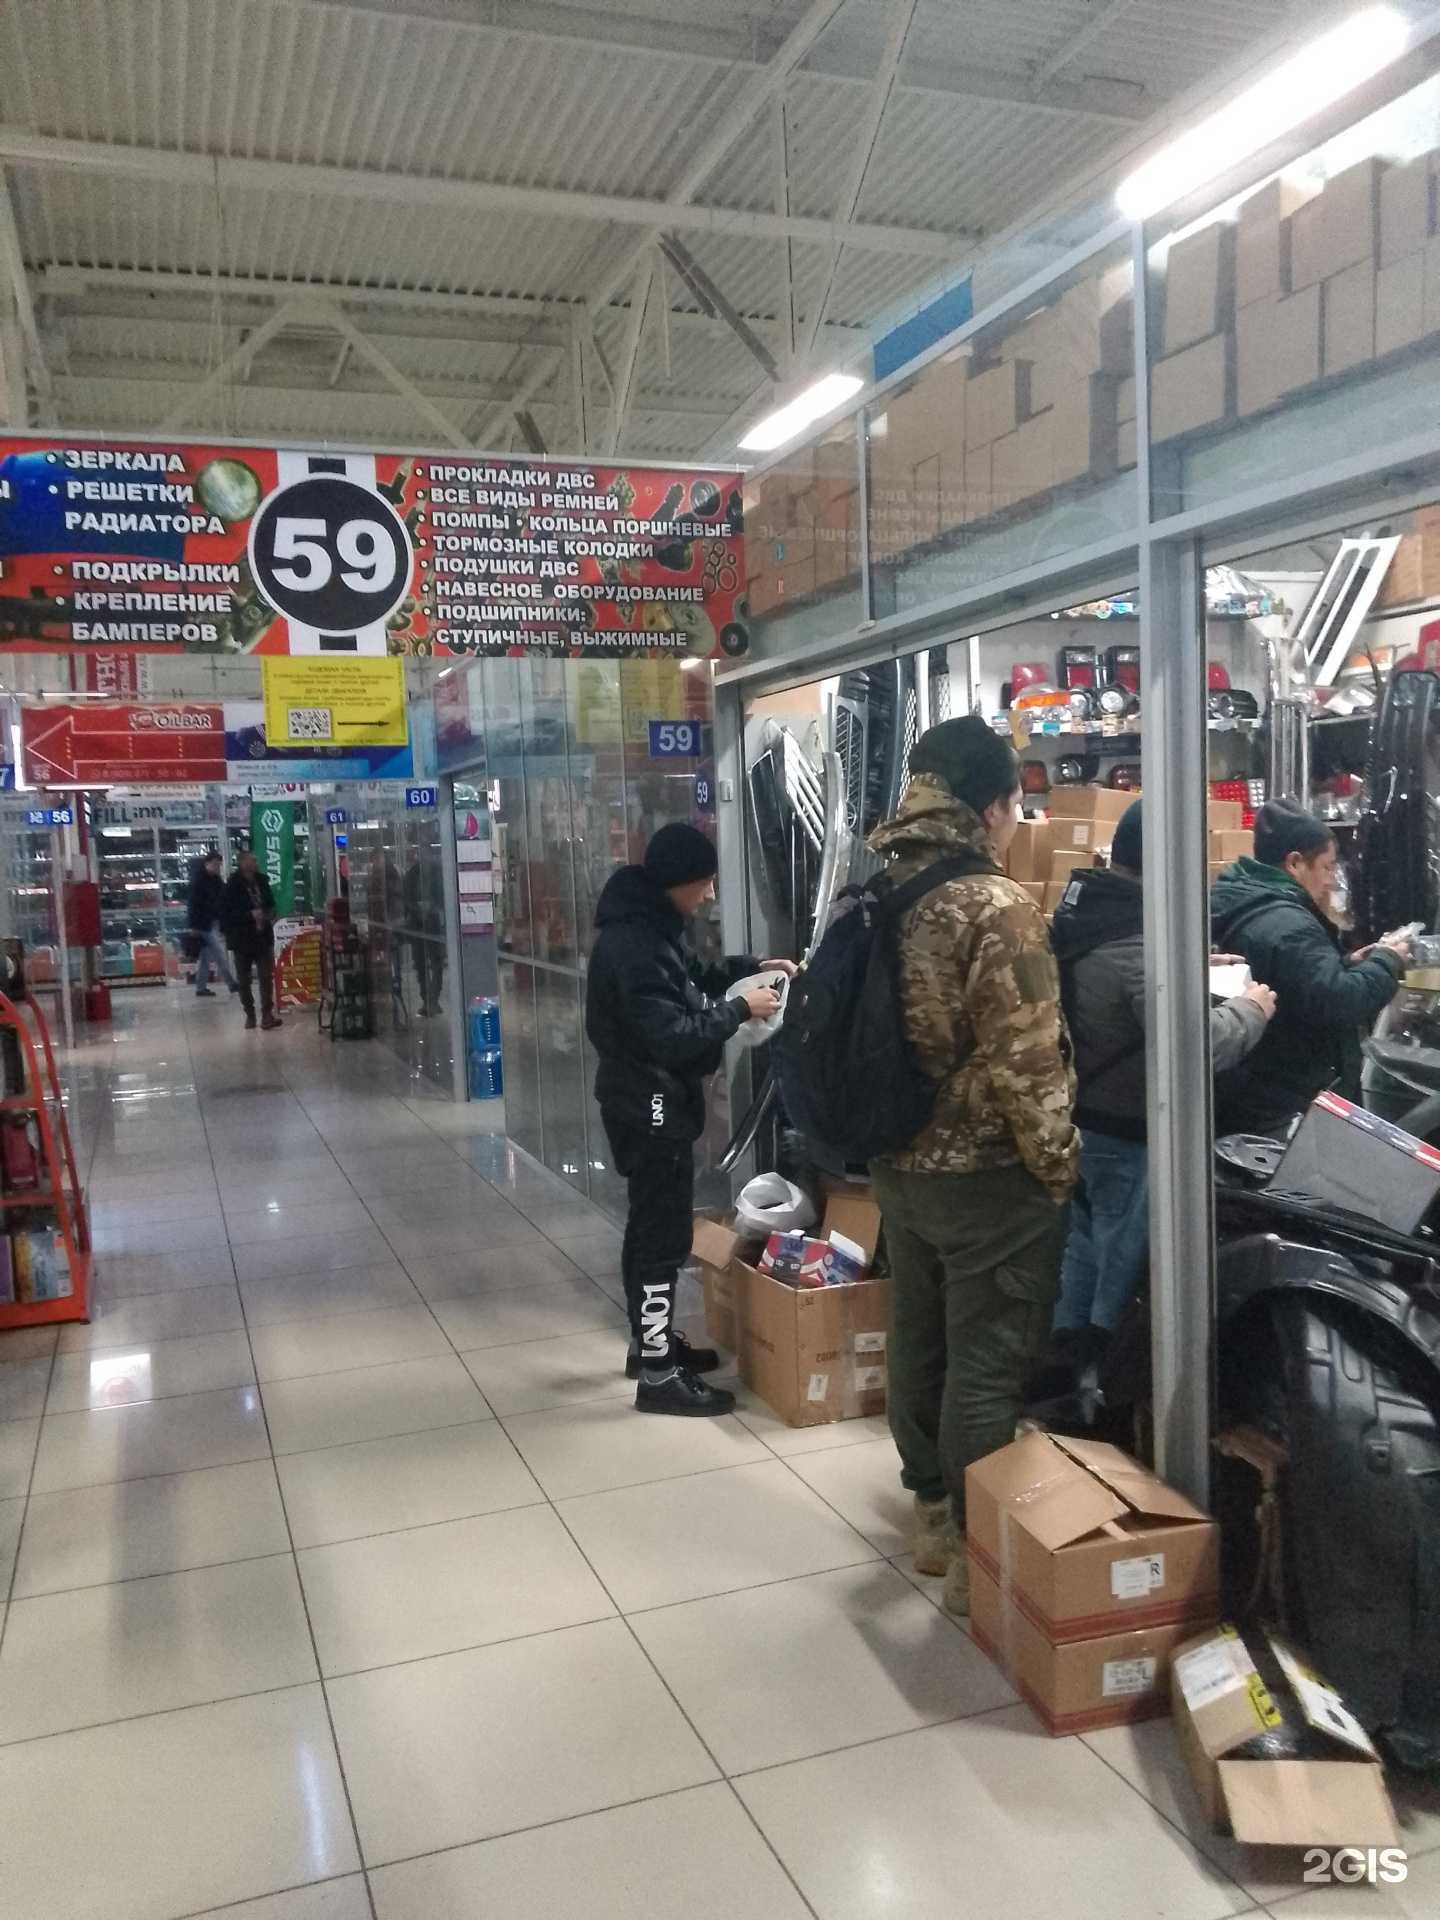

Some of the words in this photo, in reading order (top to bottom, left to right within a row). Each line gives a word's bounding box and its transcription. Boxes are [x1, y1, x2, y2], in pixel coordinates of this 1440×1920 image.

[64, 451, 186, 473] ЗЕРКАЛА
[429, 465, 551, 488] ПРОКЛАДКИ
[556, 471, 596, 490] ДВС
[66, 480, 194, 503] РЕШЕТКИ
[430, 488, 471, 504] ВСЕ
[476, 491, 536, 509] ВИДЫ
[541, 490, 619, 512] РЕМНЕЙ
[65, 514, 226, 536] РАДИАТОРА
[431, 511, 510, 530] ПОМПЫ
[529, 515, 608, 536] КОЛЬЦА
[613, 519, 732, 538] ПОРШНЕВЫЕ
[271, 517, 397, 594] 59
[433, 535, 559, 555] ТОРМОЗНЫЕ
[564, 539, 655, 560] КОЛОДКИ
[72, 561, 240, 584] ПОДКРЫЛКИ
[434, 557, 536, 577] ПОДУШКИ
[540, 560, 580, 578] ДВС
[74, 592, 232, 612] КРЕПЛЕНИЕ
[435, 581, 543, 599] НАВЕСНОЕ
[553, 584, 704, 602] ОБОРУДОВАНИЕ
[437, 604, 586, 623] ПОДШИПНИКИ:
[72, 623, 218, 642] БАМПЕРОВ
[436, 628, 566, 648] СТУПИЧНЫЕ,
[570, 630, 689, 647] ВЫЖИМНЫЕ
[158, 714, 211, 728] OILBAR
[659, 725, 693, 751] 59
[410, 790, 430, 804] 60
[697, 782, 708, 803] 59
[52, 810, 70, 823] 56
[330, 812, 343, 822] 61
[266, 836, 281, 886] SATA
